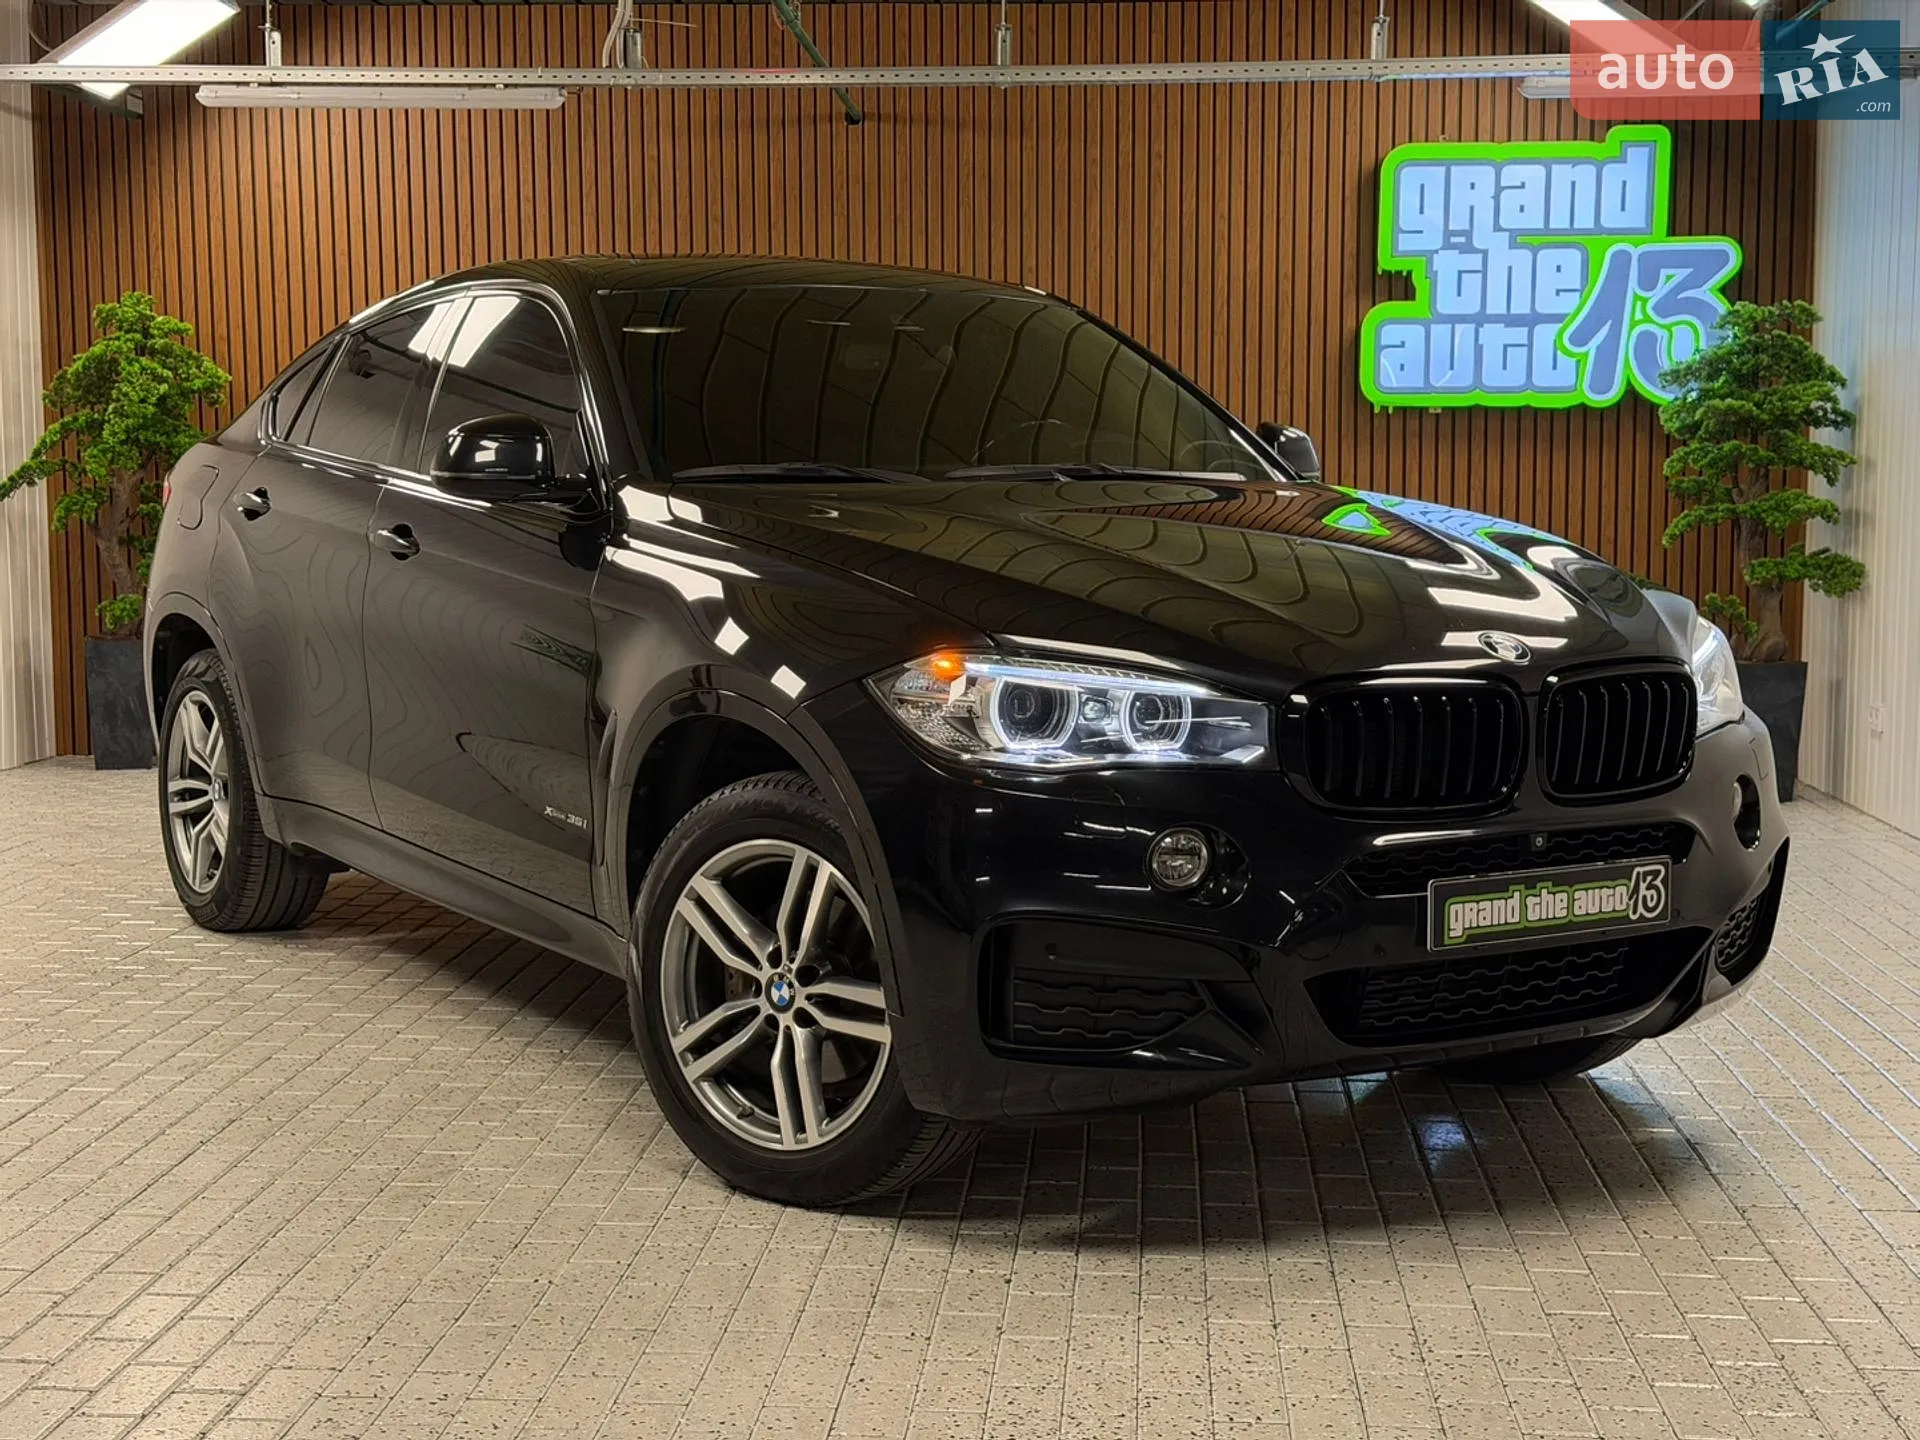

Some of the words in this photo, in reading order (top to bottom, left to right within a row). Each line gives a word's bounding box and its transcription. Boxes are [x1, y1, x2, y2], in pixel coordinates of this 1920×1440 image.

[1432, 232, 1583, 315] the
[1379, 323, 1579, 388] auto
[1563, 243, 1738, 401] 13
[1526, 887, 1568, 921] the
[1573, 885, 1628, 915] auto
[1627, 864, 1666, 920] 13
